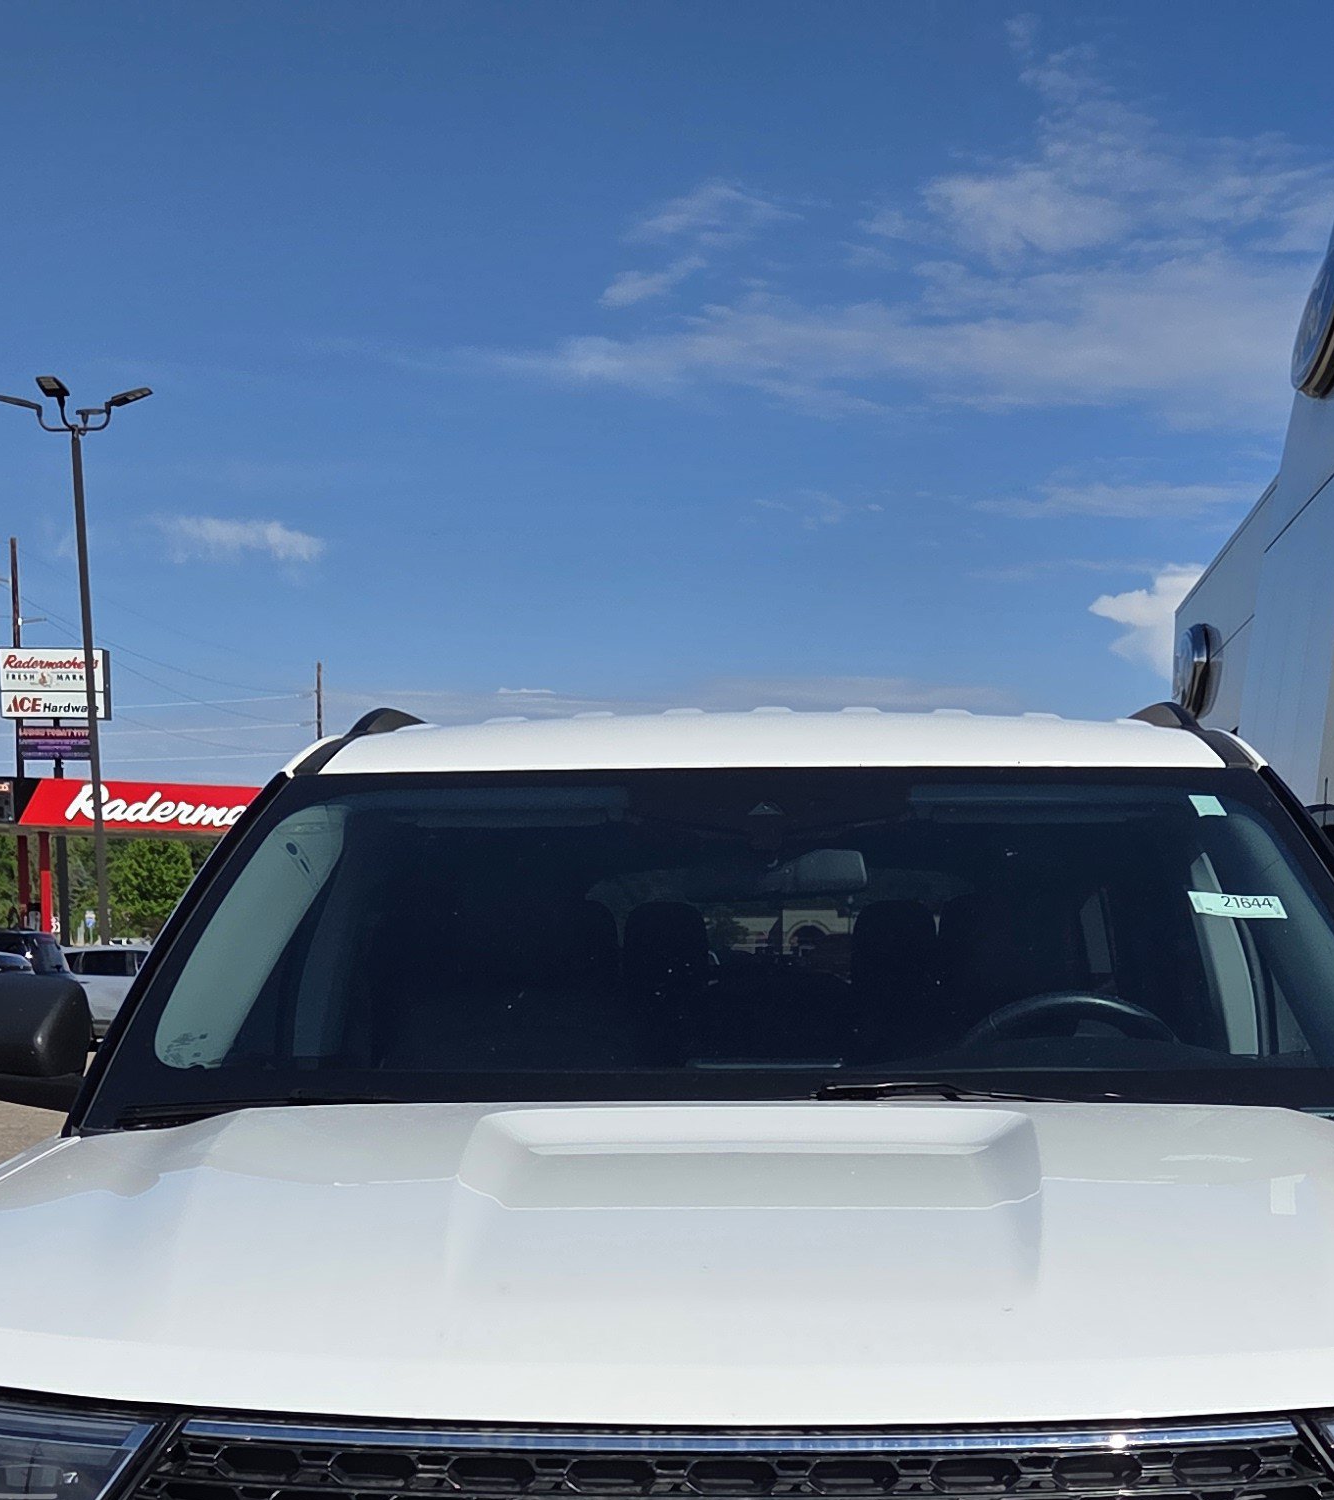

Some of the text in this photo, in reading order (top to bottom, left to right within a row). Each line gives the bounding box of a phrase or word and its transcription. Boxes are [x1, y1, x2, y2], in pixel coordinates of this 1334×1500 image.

[6, 695, 99, 713] ACE Hardwae
[1220, 895, 1273, 909] 21644
